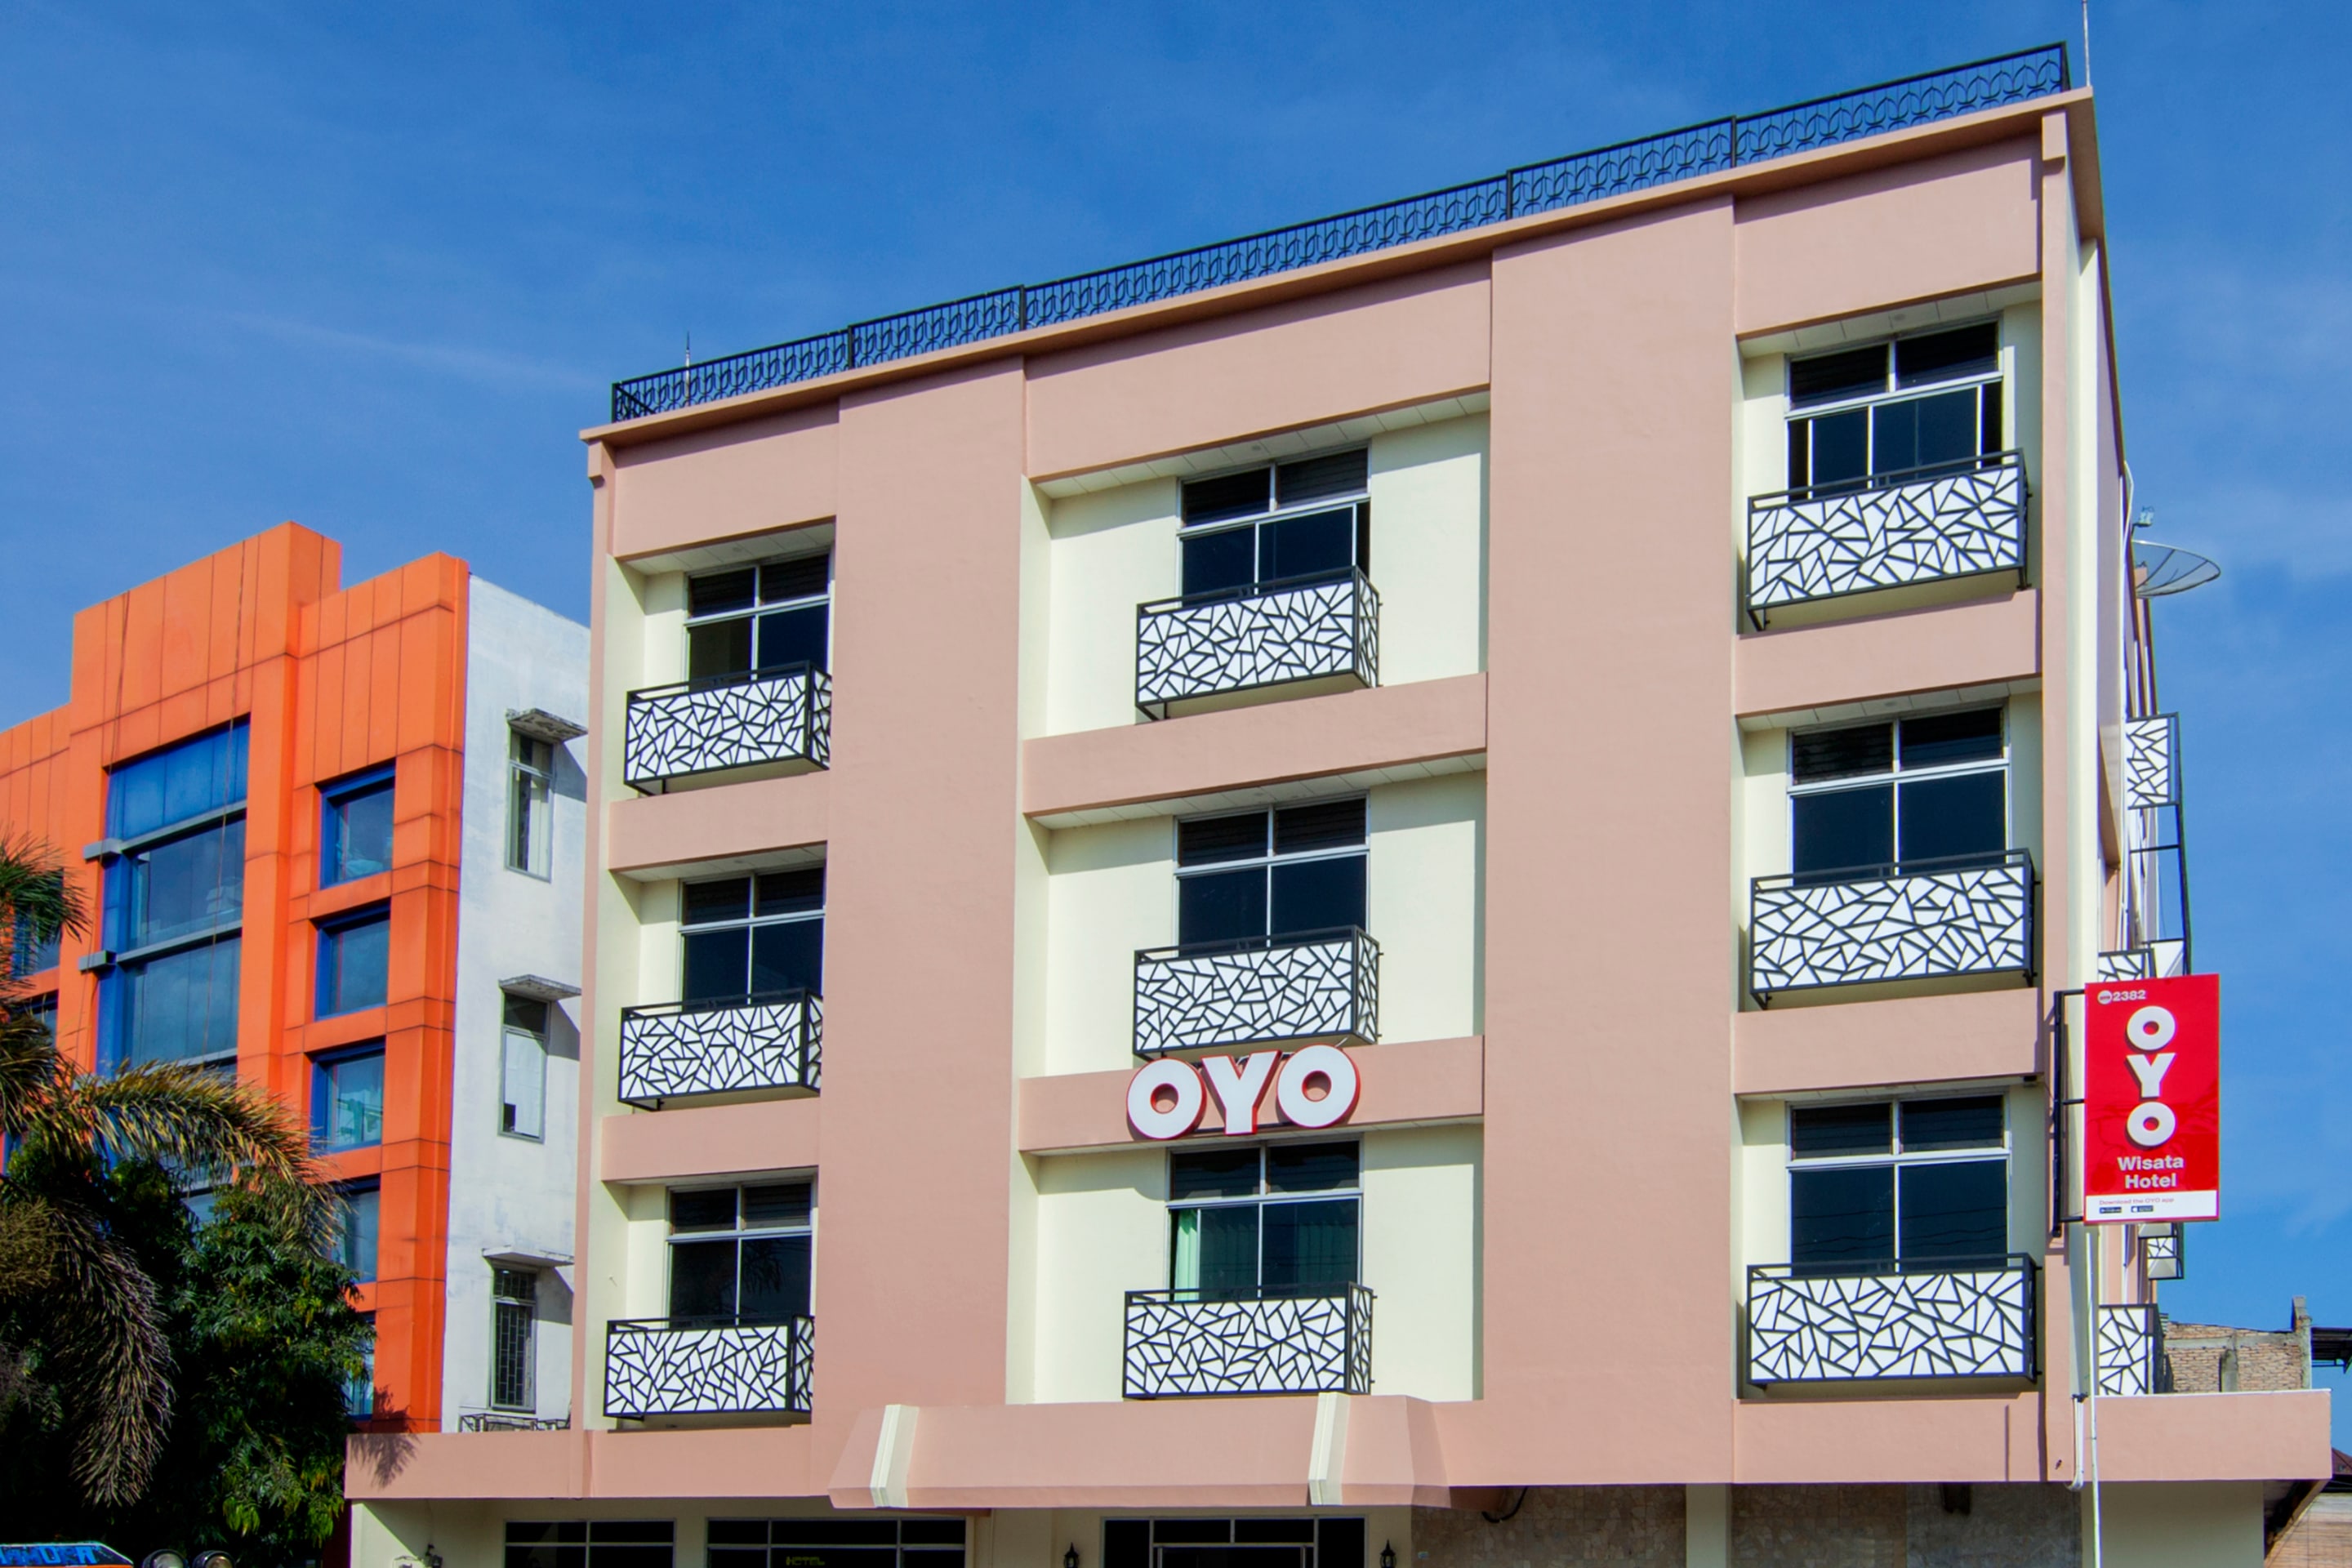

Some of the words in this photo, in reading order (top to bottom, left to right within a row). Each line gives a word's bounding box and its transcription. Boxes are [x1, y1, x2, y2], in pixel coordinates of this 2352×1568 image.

[2113, 989, 2147, 1001] 2382
[2126, 1005, 2176, 1147] OYO
[1126, 1044, 1361, 1140] OYO
[2117, 1154, 2185, 1171] Wisata
[2125, 1172, 2177, 1189] Hotel
